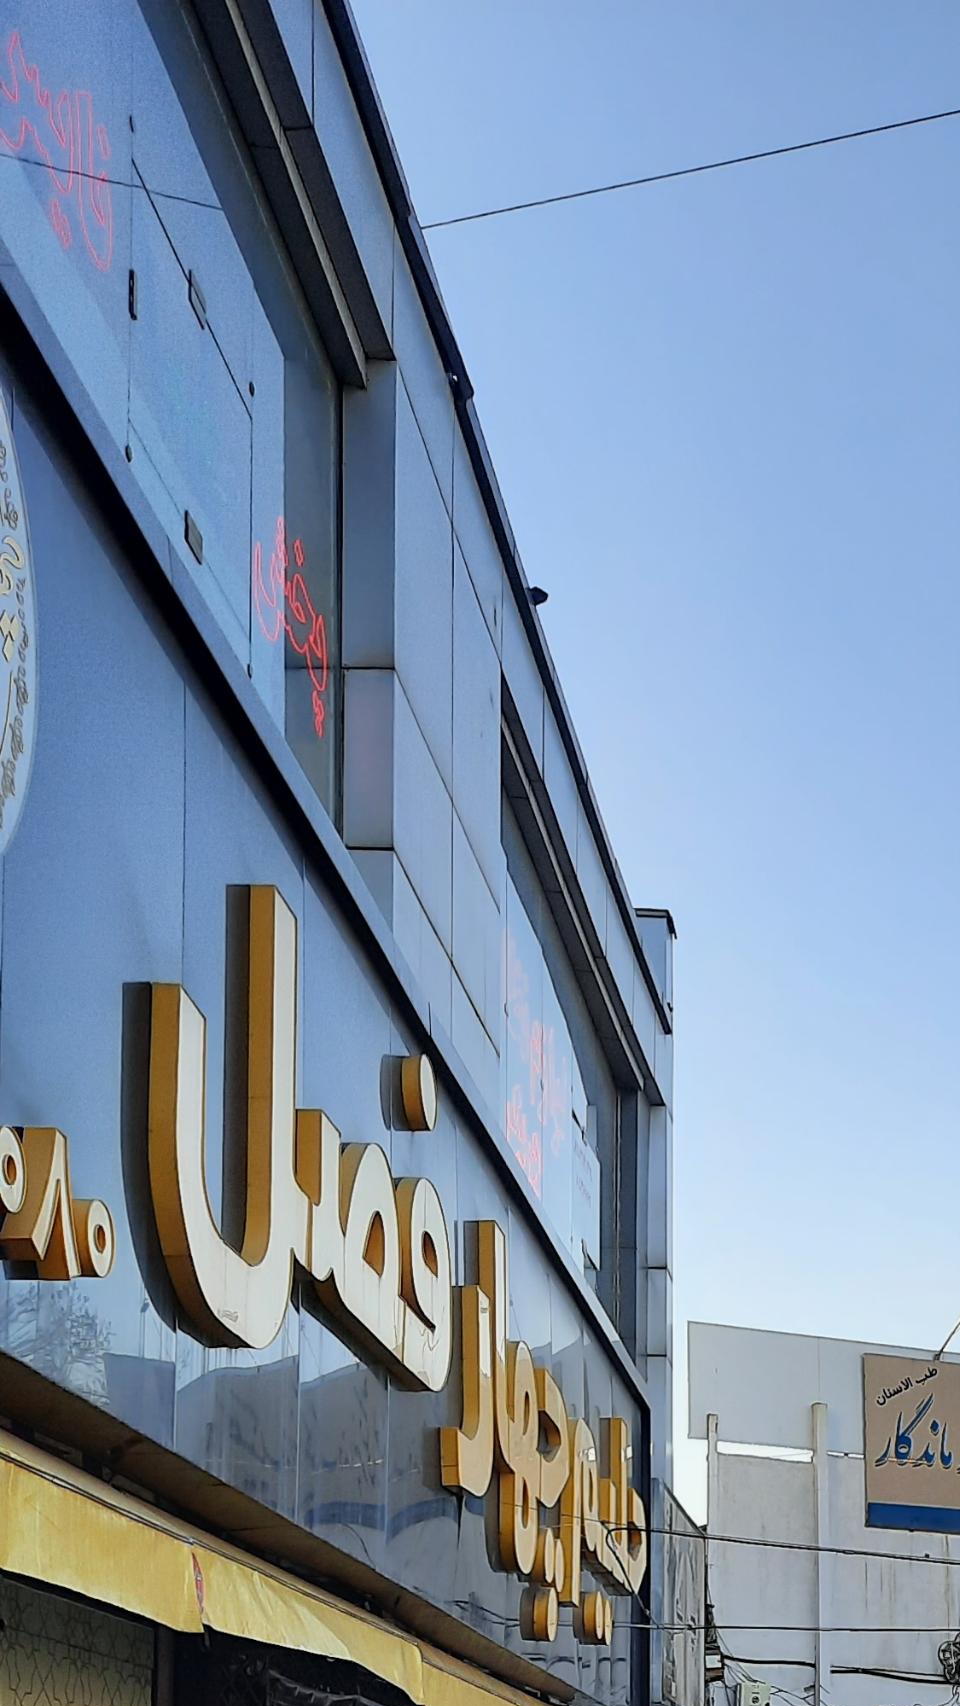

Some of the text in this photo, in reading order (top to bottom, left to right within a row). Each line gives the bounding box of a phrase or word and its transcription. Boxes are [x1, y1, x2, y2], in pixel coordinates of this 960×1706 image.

[150, 885, 453, 1391] فصل
[442, 1221, 570, 1642] چهار
[875, 1393, 953, 1469] ماندگار
[915, 1366, 938, 1385] طب
[562, 1417, 648, 1646] حلیم
